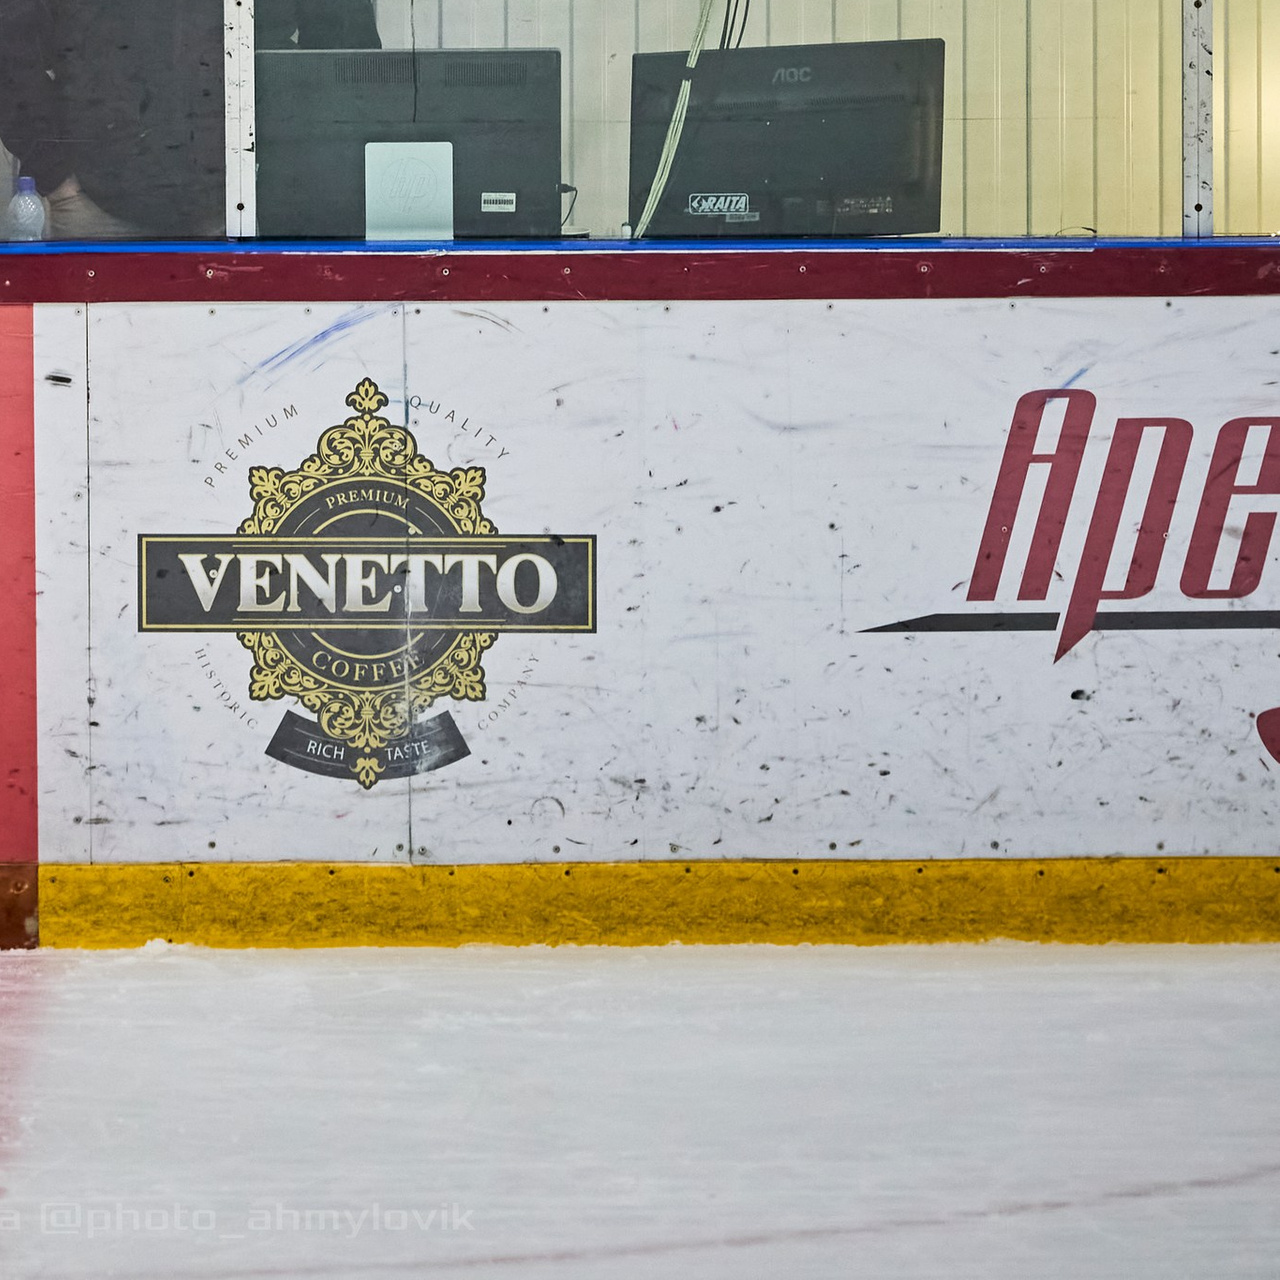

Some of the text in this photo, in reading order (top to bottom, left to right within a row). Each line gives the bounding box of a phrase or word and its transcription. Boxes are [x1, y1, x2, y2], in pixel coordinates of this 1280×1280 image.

[204, 394, 511, 488] PREMIUM QUALITY
[324, 488, 411, 511] PREMIUM
[177, 552, 558, 615] VENETTO
[193, 648, 541, 731] HISTORIC COMPANY
[311, 649, 427, 682] COFFEE
[306, 739, 431, 762] RICH TASTE
